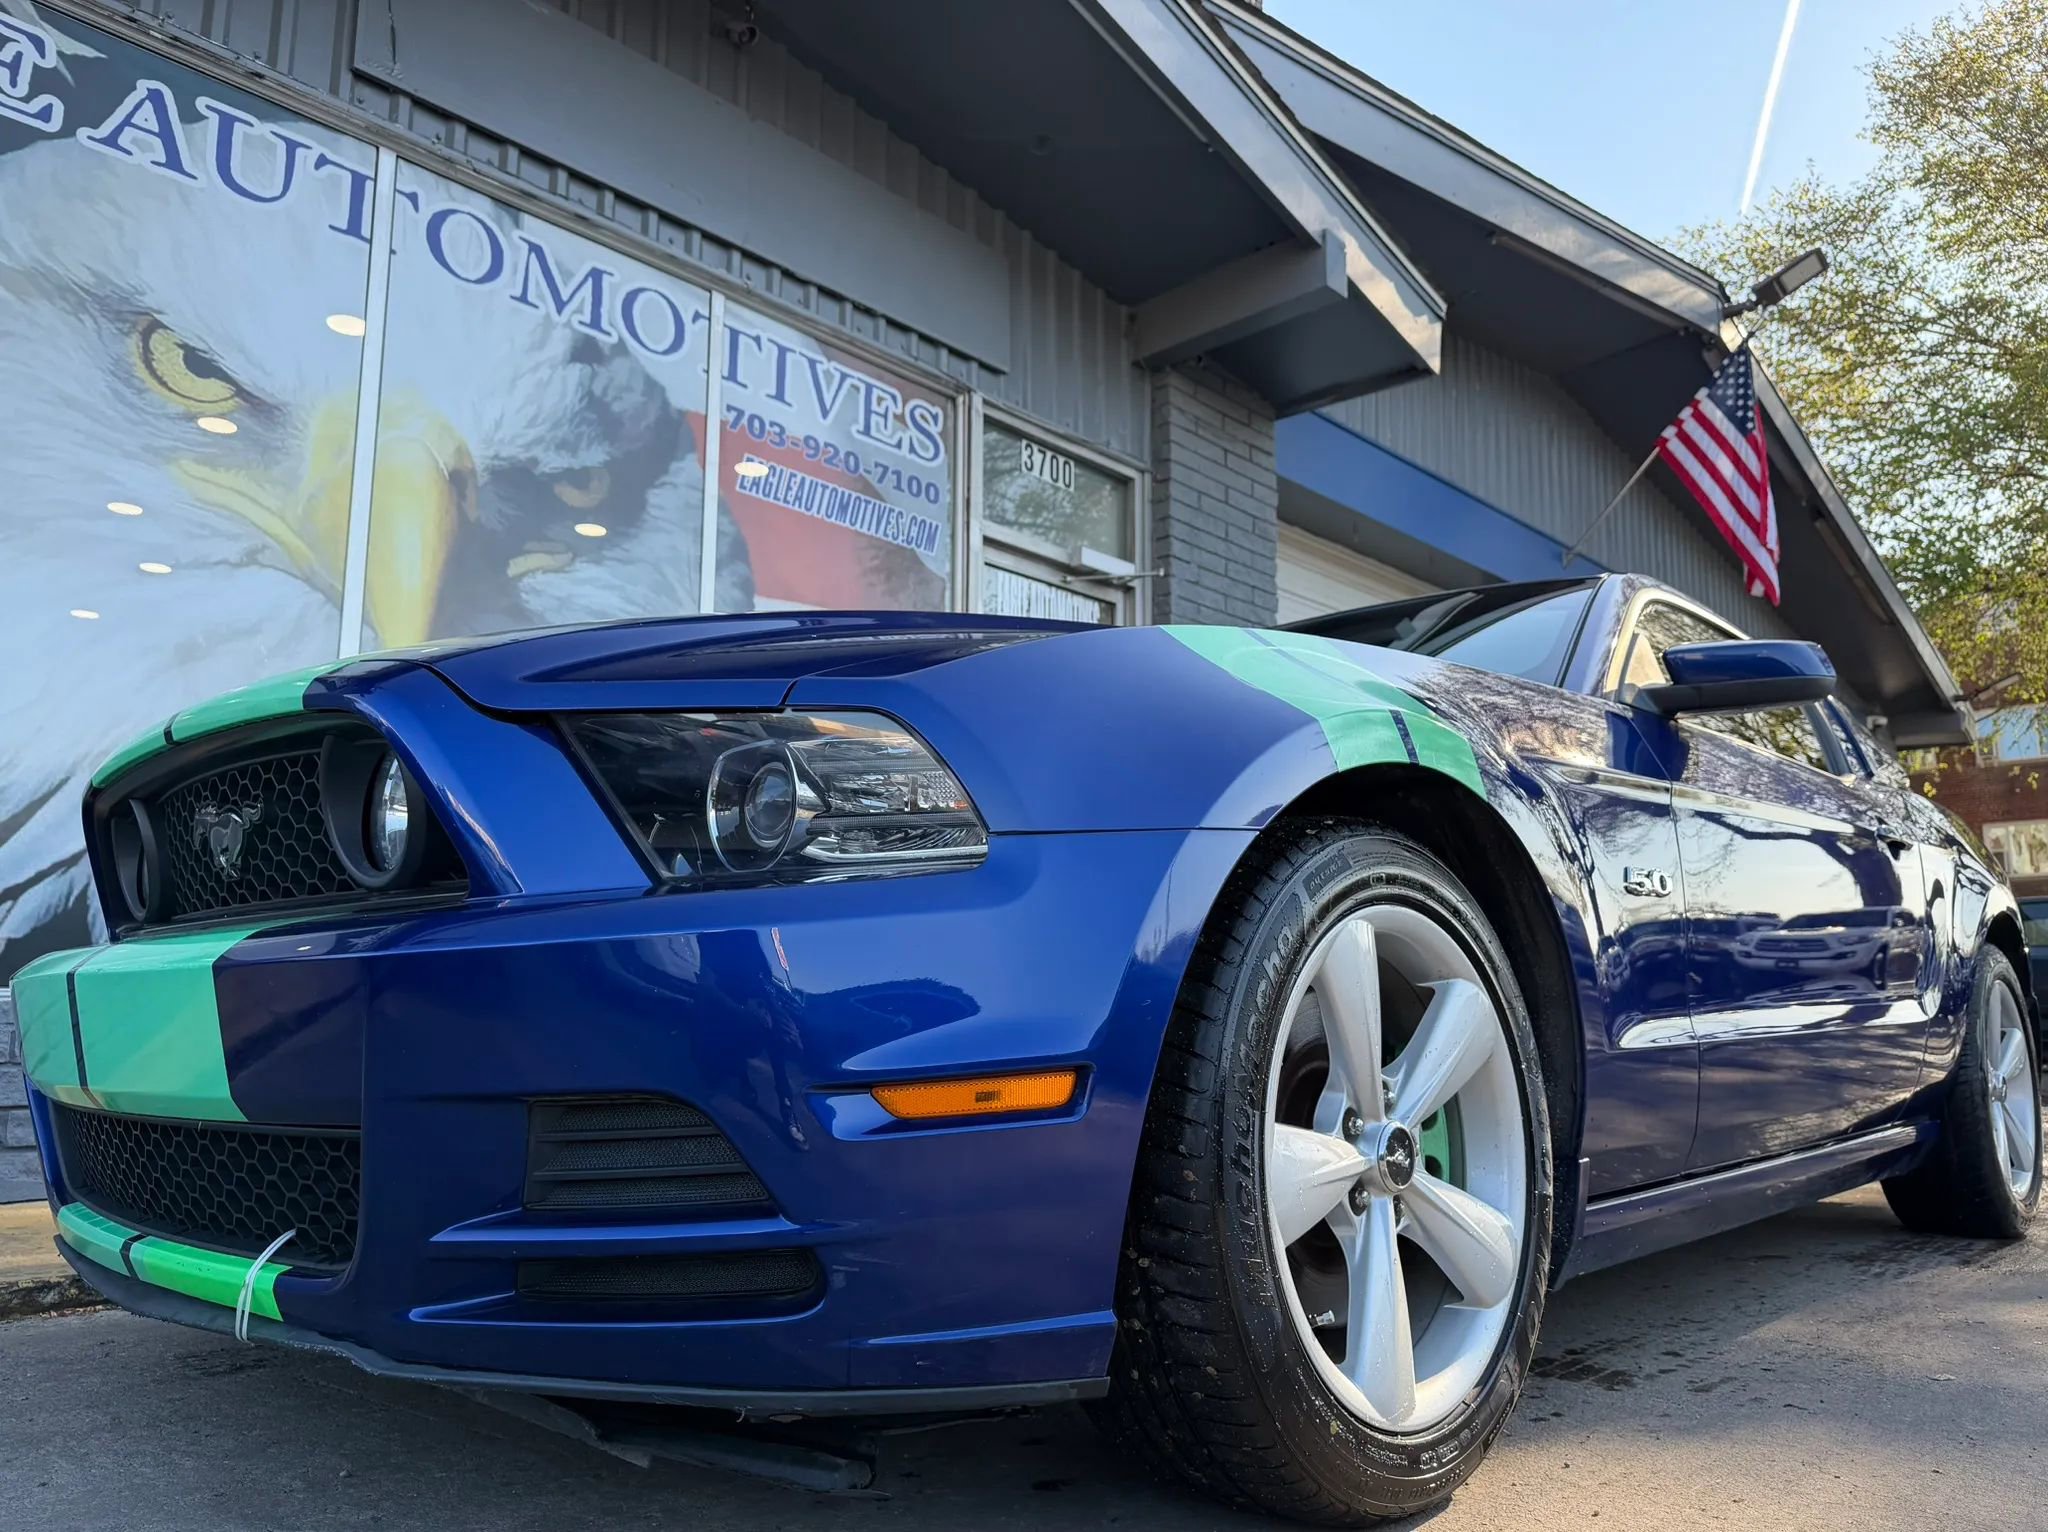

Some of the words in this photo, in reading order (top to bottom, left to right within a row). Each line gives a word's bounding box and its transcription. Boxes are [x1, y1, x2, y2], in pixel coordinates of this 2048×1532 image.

[84, 86, 943, 463] AUTOMOTIVES
[726, 404, 940, 505] 703-920-7100
[1024, 442, 1072, 489] 3700
